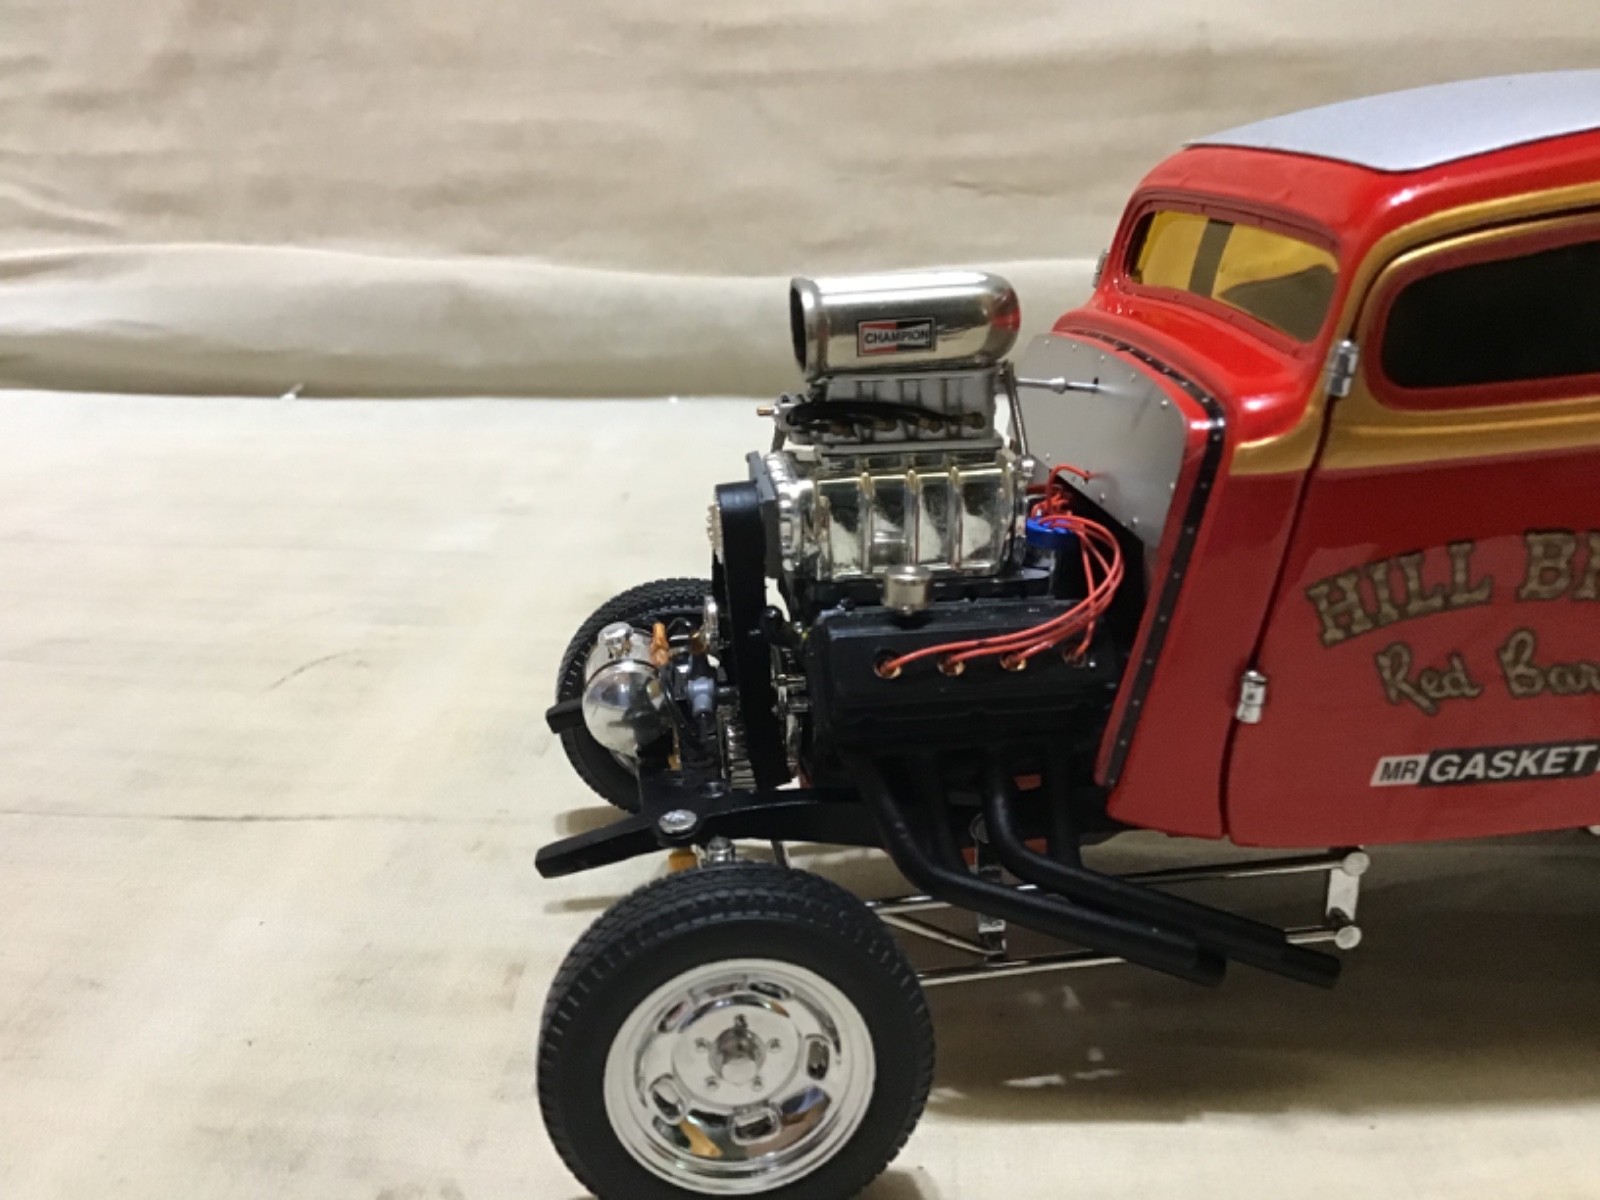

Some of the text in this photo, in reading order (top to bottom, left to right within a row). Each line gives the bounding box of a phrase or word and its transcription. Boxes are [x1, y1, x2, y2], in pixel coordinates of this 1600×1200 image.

[864, 329, 929, 344] CHAMPION
[1306, 538, 1493, 646] HILL
[1375, 642, 1484, 714] Red
[1379, 744, 1597, 782] MR GASKET
